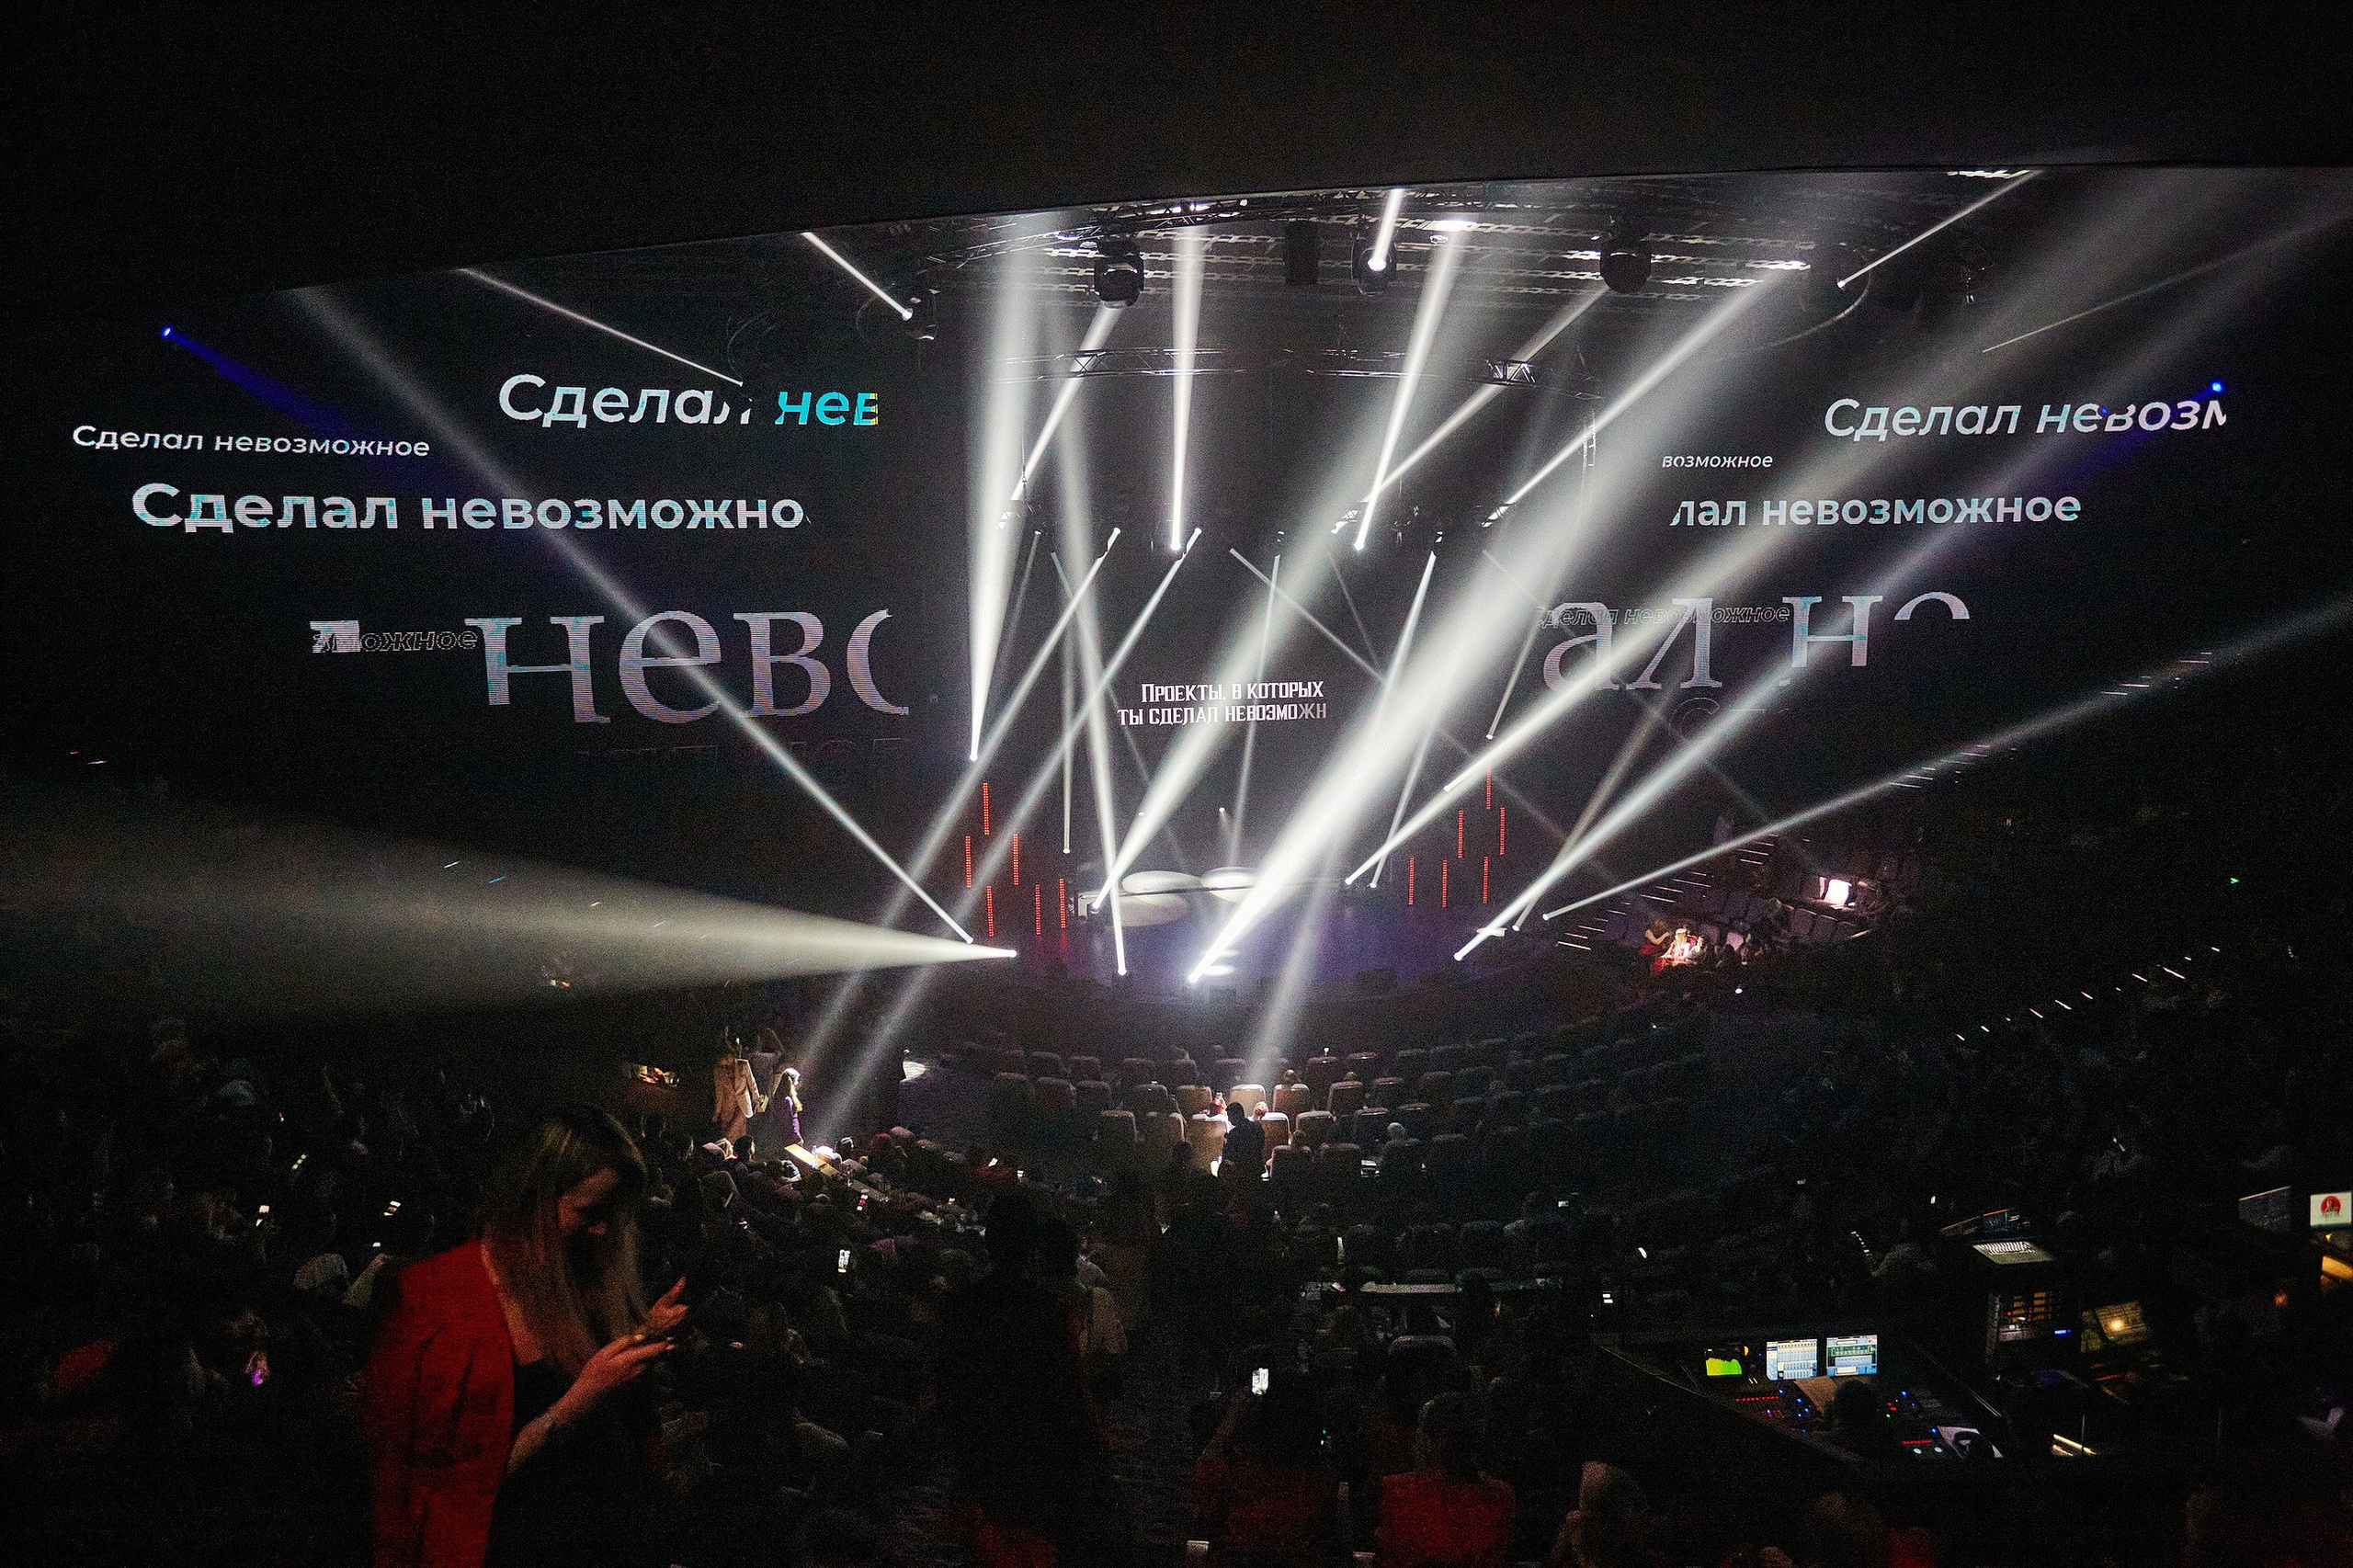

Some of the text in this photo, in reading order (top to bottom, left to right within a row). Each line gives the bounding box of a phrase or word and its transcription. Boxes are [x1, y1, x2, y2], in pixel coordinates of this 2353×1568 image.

[1824, 398, 2021, 442] Сделал
[73, 425, 430, 457] Сделал невозможное
[1662, 454, 1773, 469] возможное
[132, 483, 804, 534] Сделал невозможно
[1762, 495, 2082, 527] невозможное
[1624, 607, 1790, 625] невоожное
